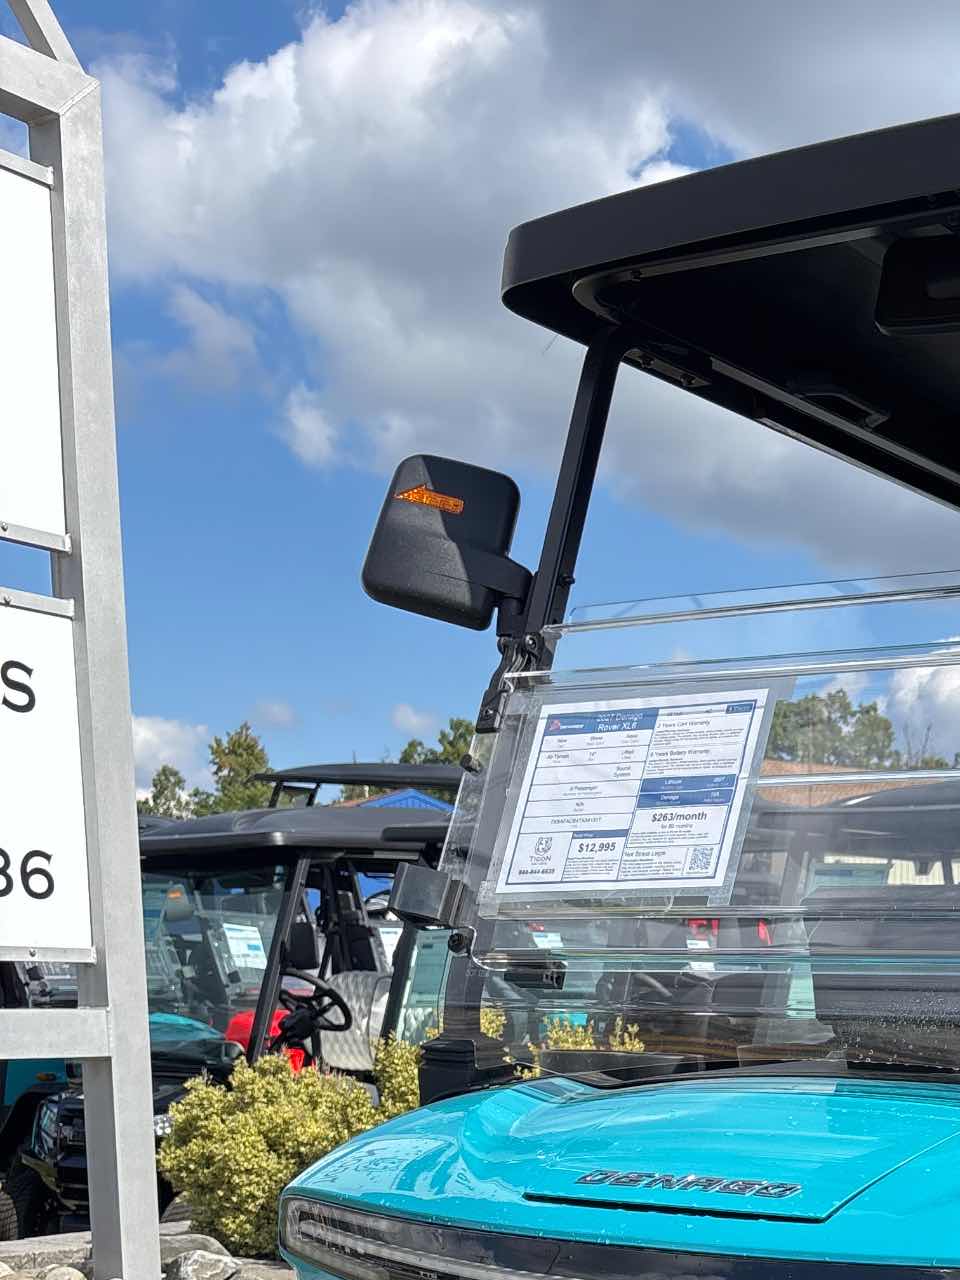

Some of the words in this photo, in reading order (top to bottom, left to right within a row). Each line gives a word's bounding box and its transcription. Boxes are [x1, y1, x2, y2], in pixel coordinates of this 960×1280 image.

[598, 723, 619, 732] Rover
[651, 811, 707, 823] $263/month
[578, 842, 616, 855] $12,995
[576, 1169, 802, 1199] DENAGO
